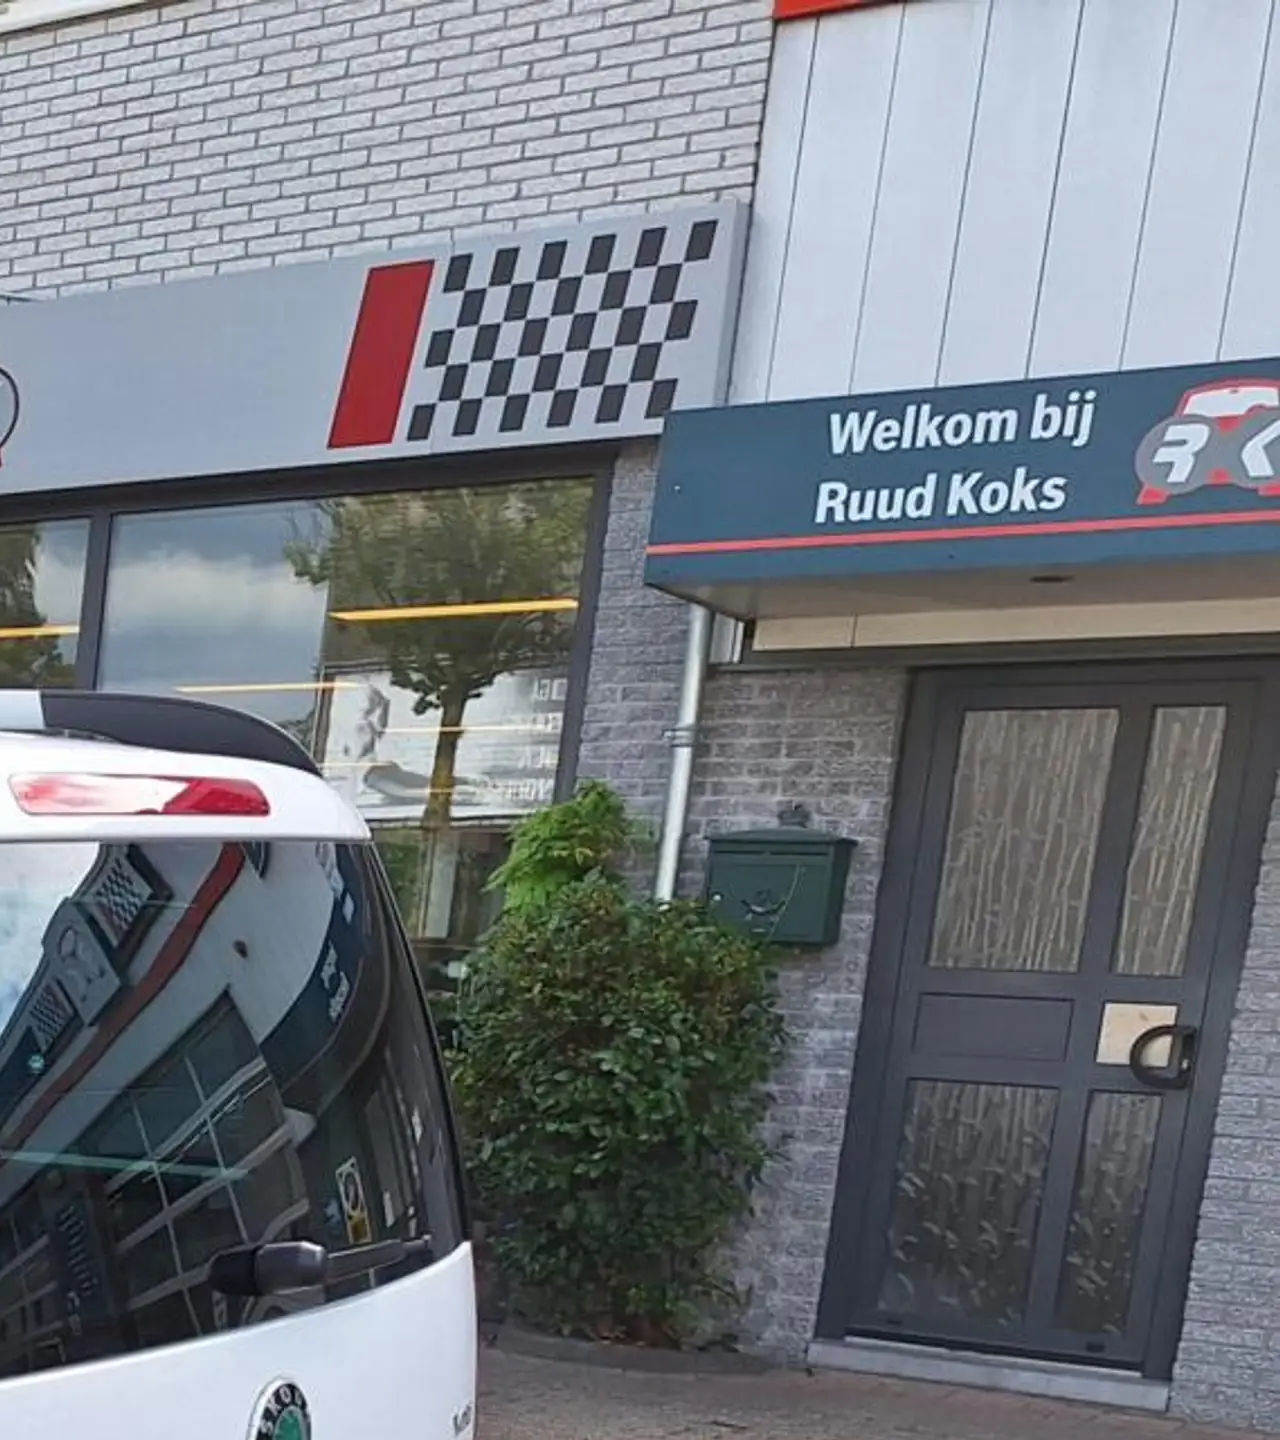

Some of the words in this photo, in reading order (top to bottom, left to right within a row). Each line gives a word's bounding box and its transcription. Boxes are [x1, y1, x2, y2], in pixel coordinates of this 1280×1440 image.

[828, 405, 1018, 456] Welkom
[1029, 388, 1098, 448] bij
[814, 475, 934, 525] Ruud
[946, 468, 1068, 516] Koks
